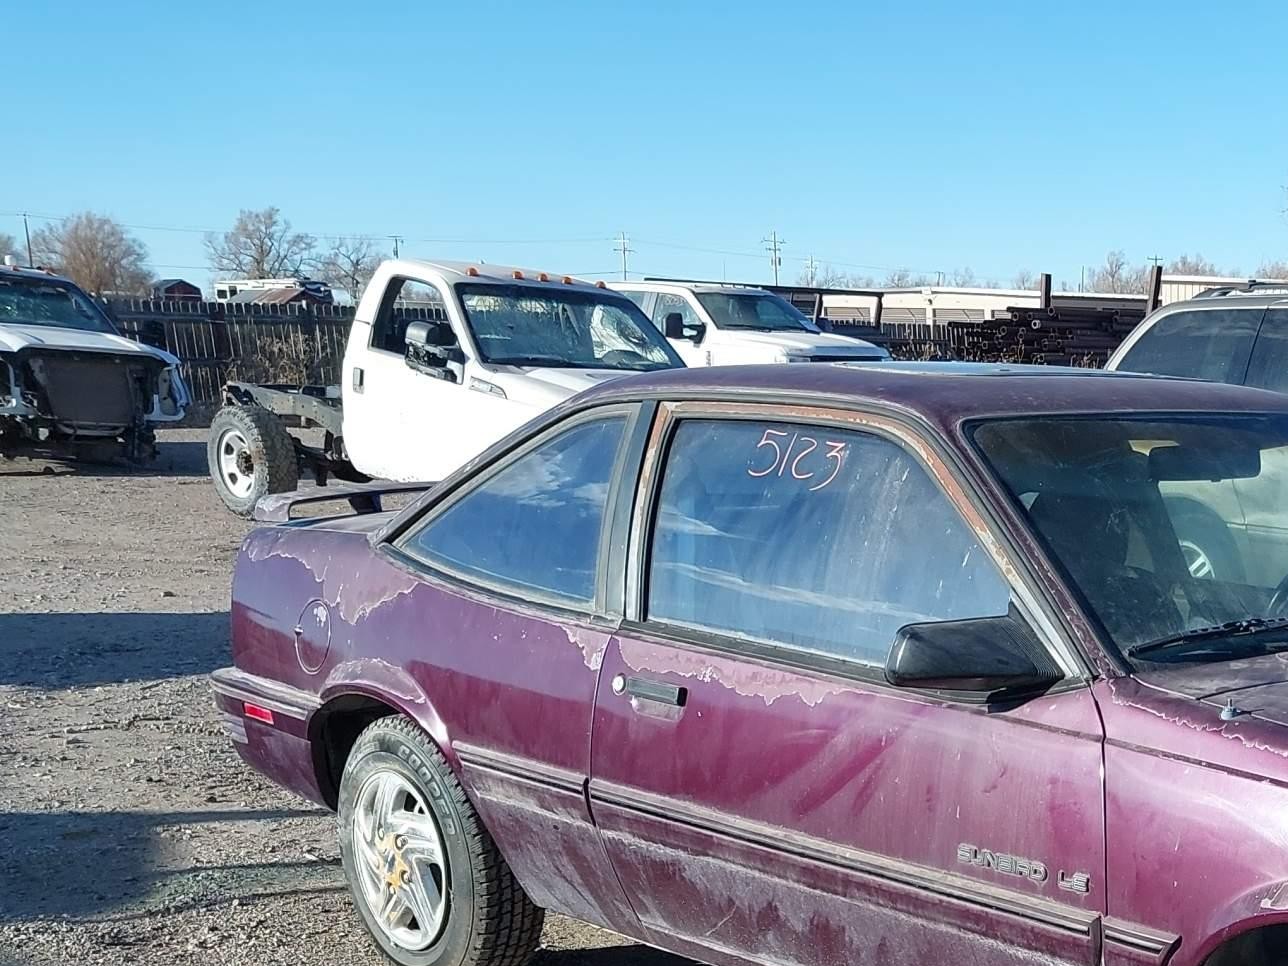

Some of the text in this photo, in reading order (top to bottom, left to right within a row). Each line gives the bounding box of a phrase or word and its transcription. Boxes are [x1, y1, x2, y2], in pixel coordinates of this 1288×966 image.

[747, 429, 846, 491] 5123
[398, 744, 456, 835] COOPER
[957, 843, 1091, 894] SUNBIRD LE
